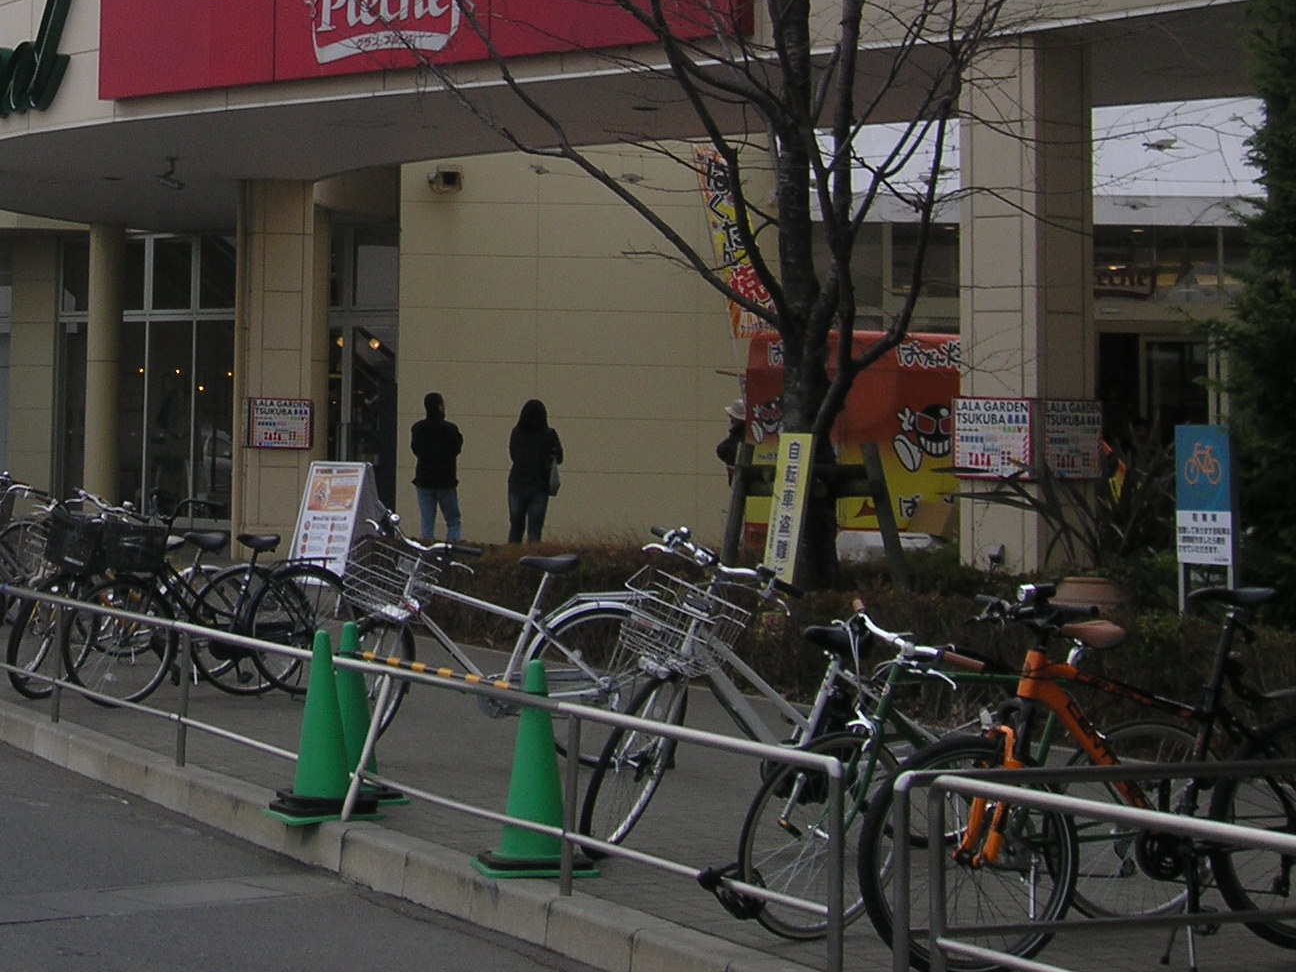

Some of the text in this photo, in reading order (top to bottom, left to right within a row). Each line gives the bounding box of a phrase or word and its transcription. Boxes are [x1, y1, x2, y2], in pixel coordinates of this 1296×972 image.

[956, 401, 1028, 413] LALA GARDEN
[957, 412, 1006, 425] TSUKUBA
